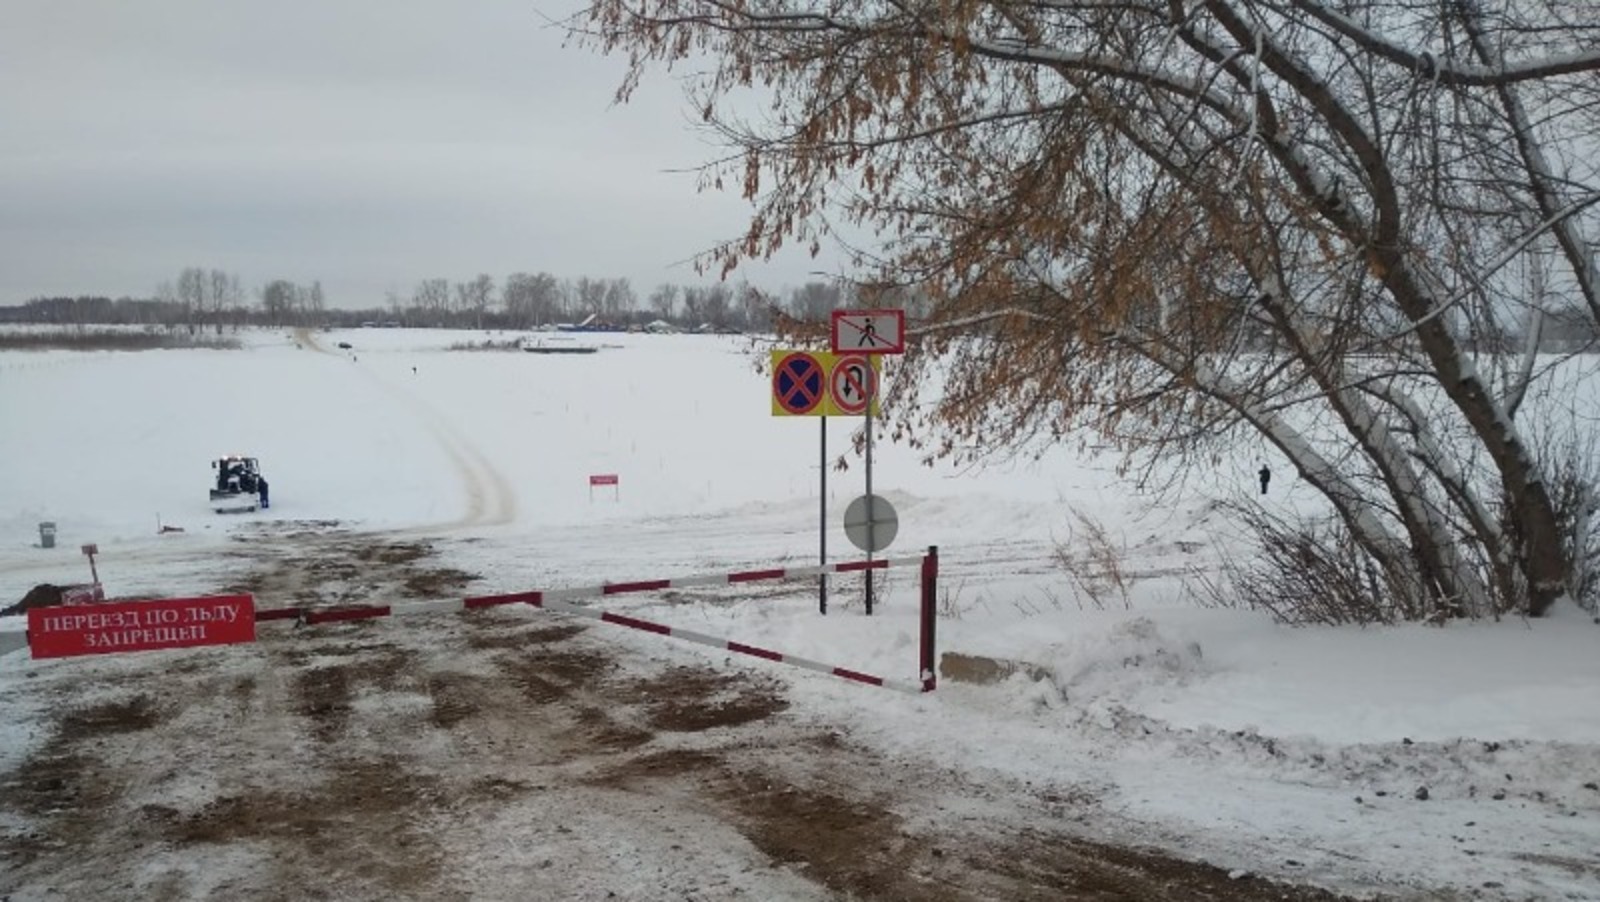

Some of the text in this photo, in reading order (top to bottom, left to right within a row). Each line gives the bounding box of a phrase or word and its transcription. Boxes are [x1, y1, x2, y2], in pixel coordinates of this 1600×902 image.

[43, 604, 240, 632] ПЕРЕЕЗД ПО ЛЬДУ
